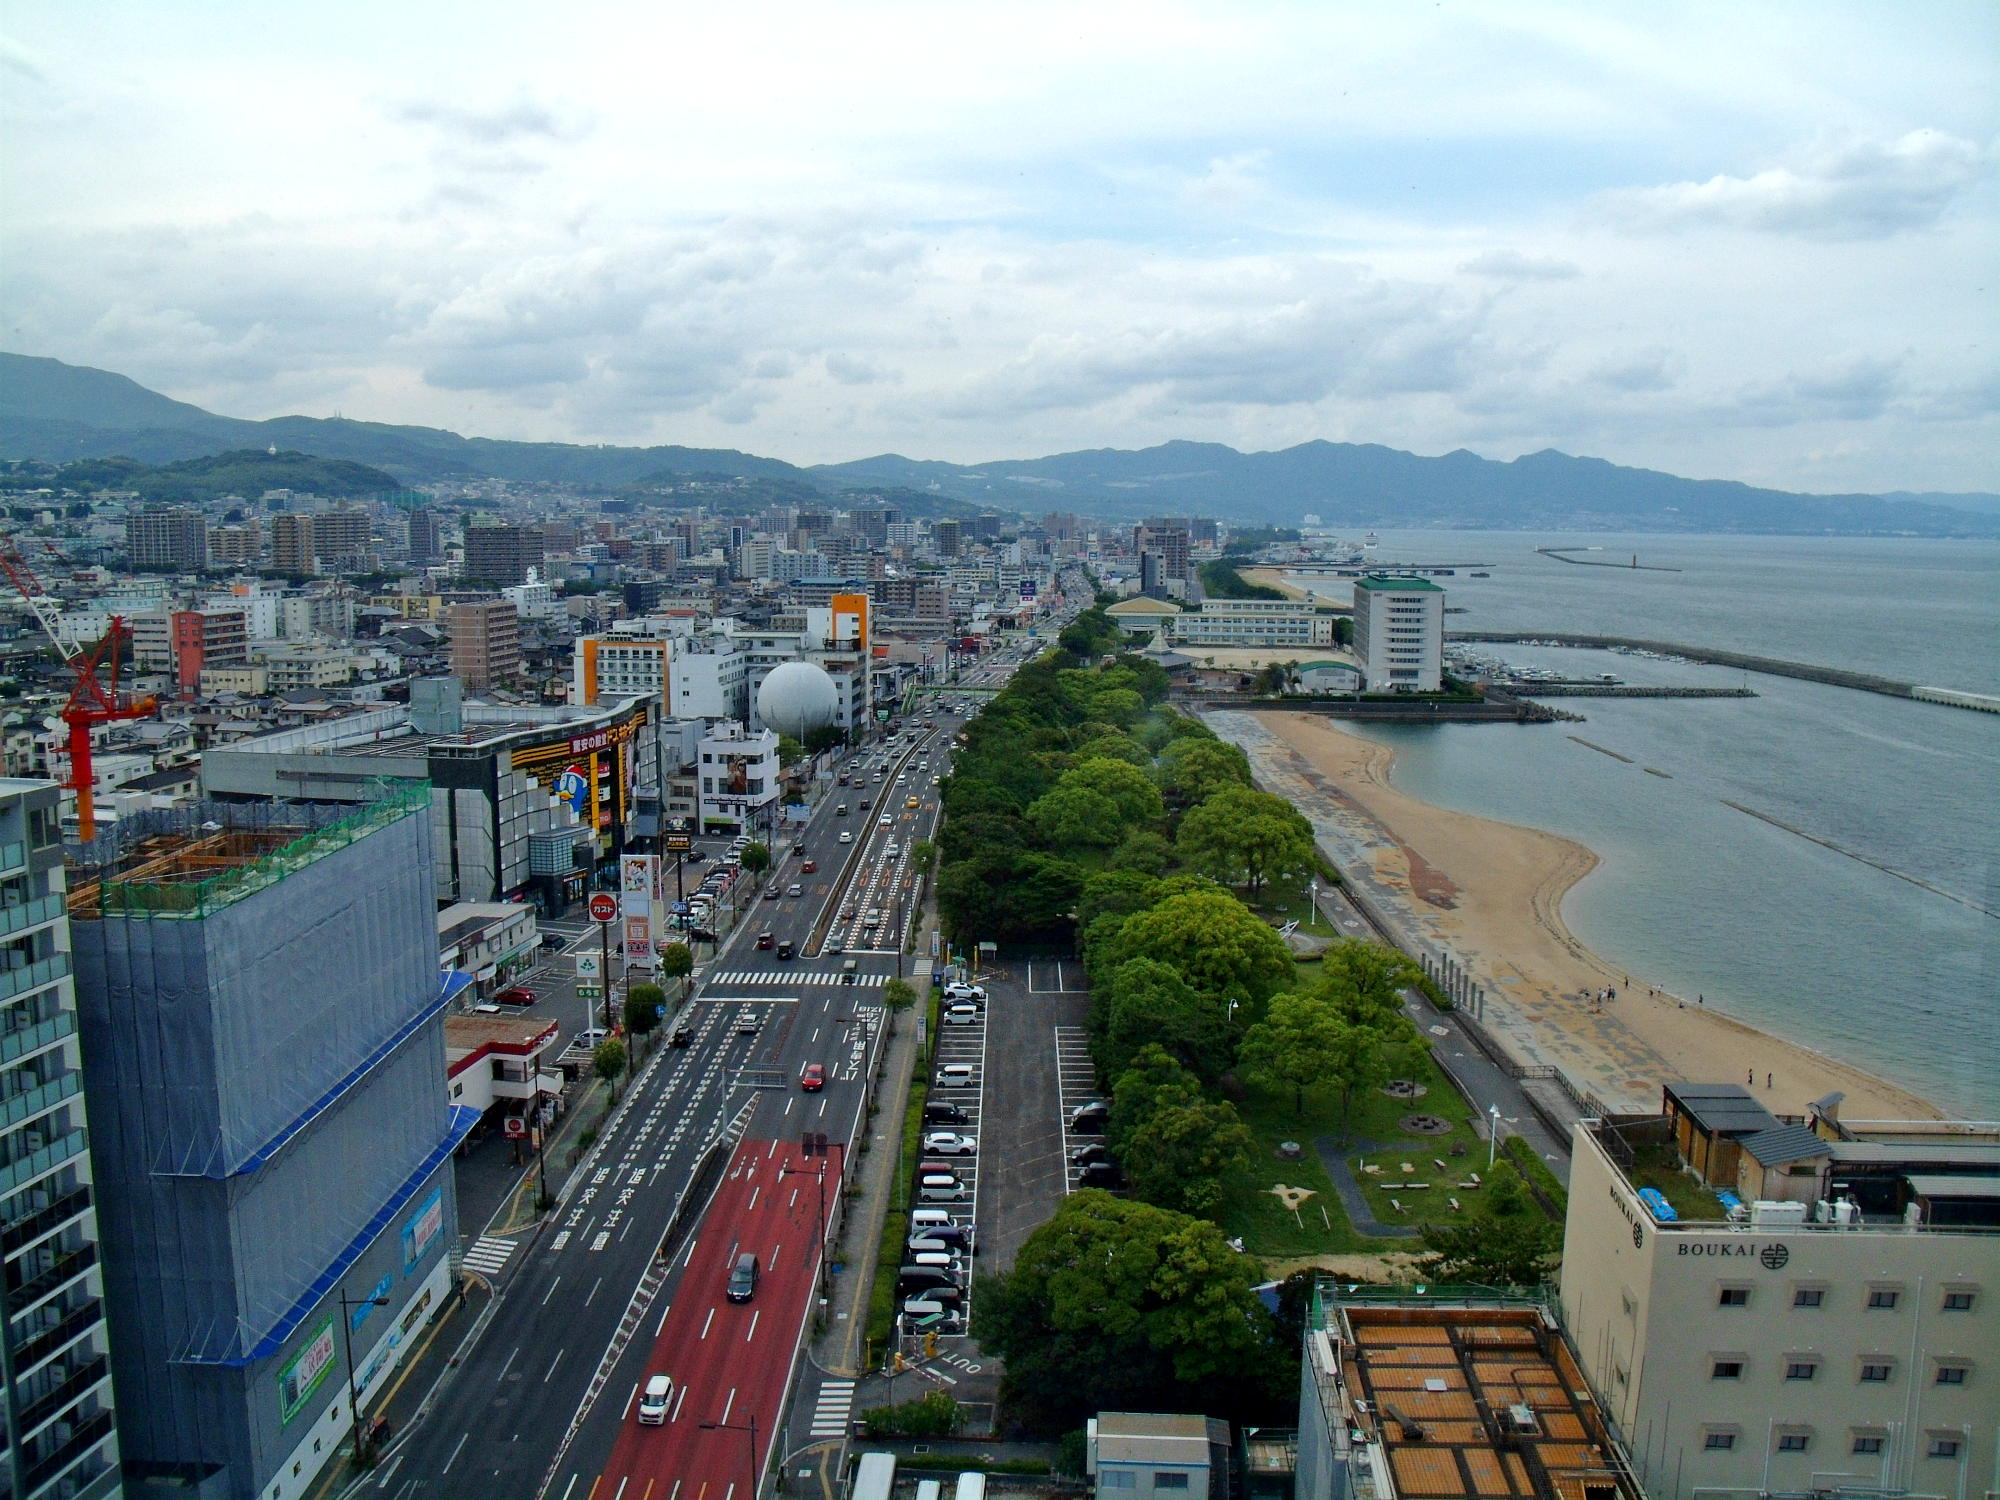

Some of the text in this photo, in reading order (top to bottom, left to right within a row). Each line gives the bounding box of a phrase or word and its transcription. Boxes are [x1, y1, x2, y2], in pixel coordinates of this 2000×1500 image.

[593, 904, 614, 914] ガスト
[839, 1040, 867, 1081] バス専用
[549, 1166, 611, 1251] 追突注意
[589, 1166, 648, 1252] 追突注意
[1609, 1184, 1634, 1225] BOUKAI
[1677, 1243, 1756, 1257] BOUKAI
[941, 1353, 982, 1374] OUT
